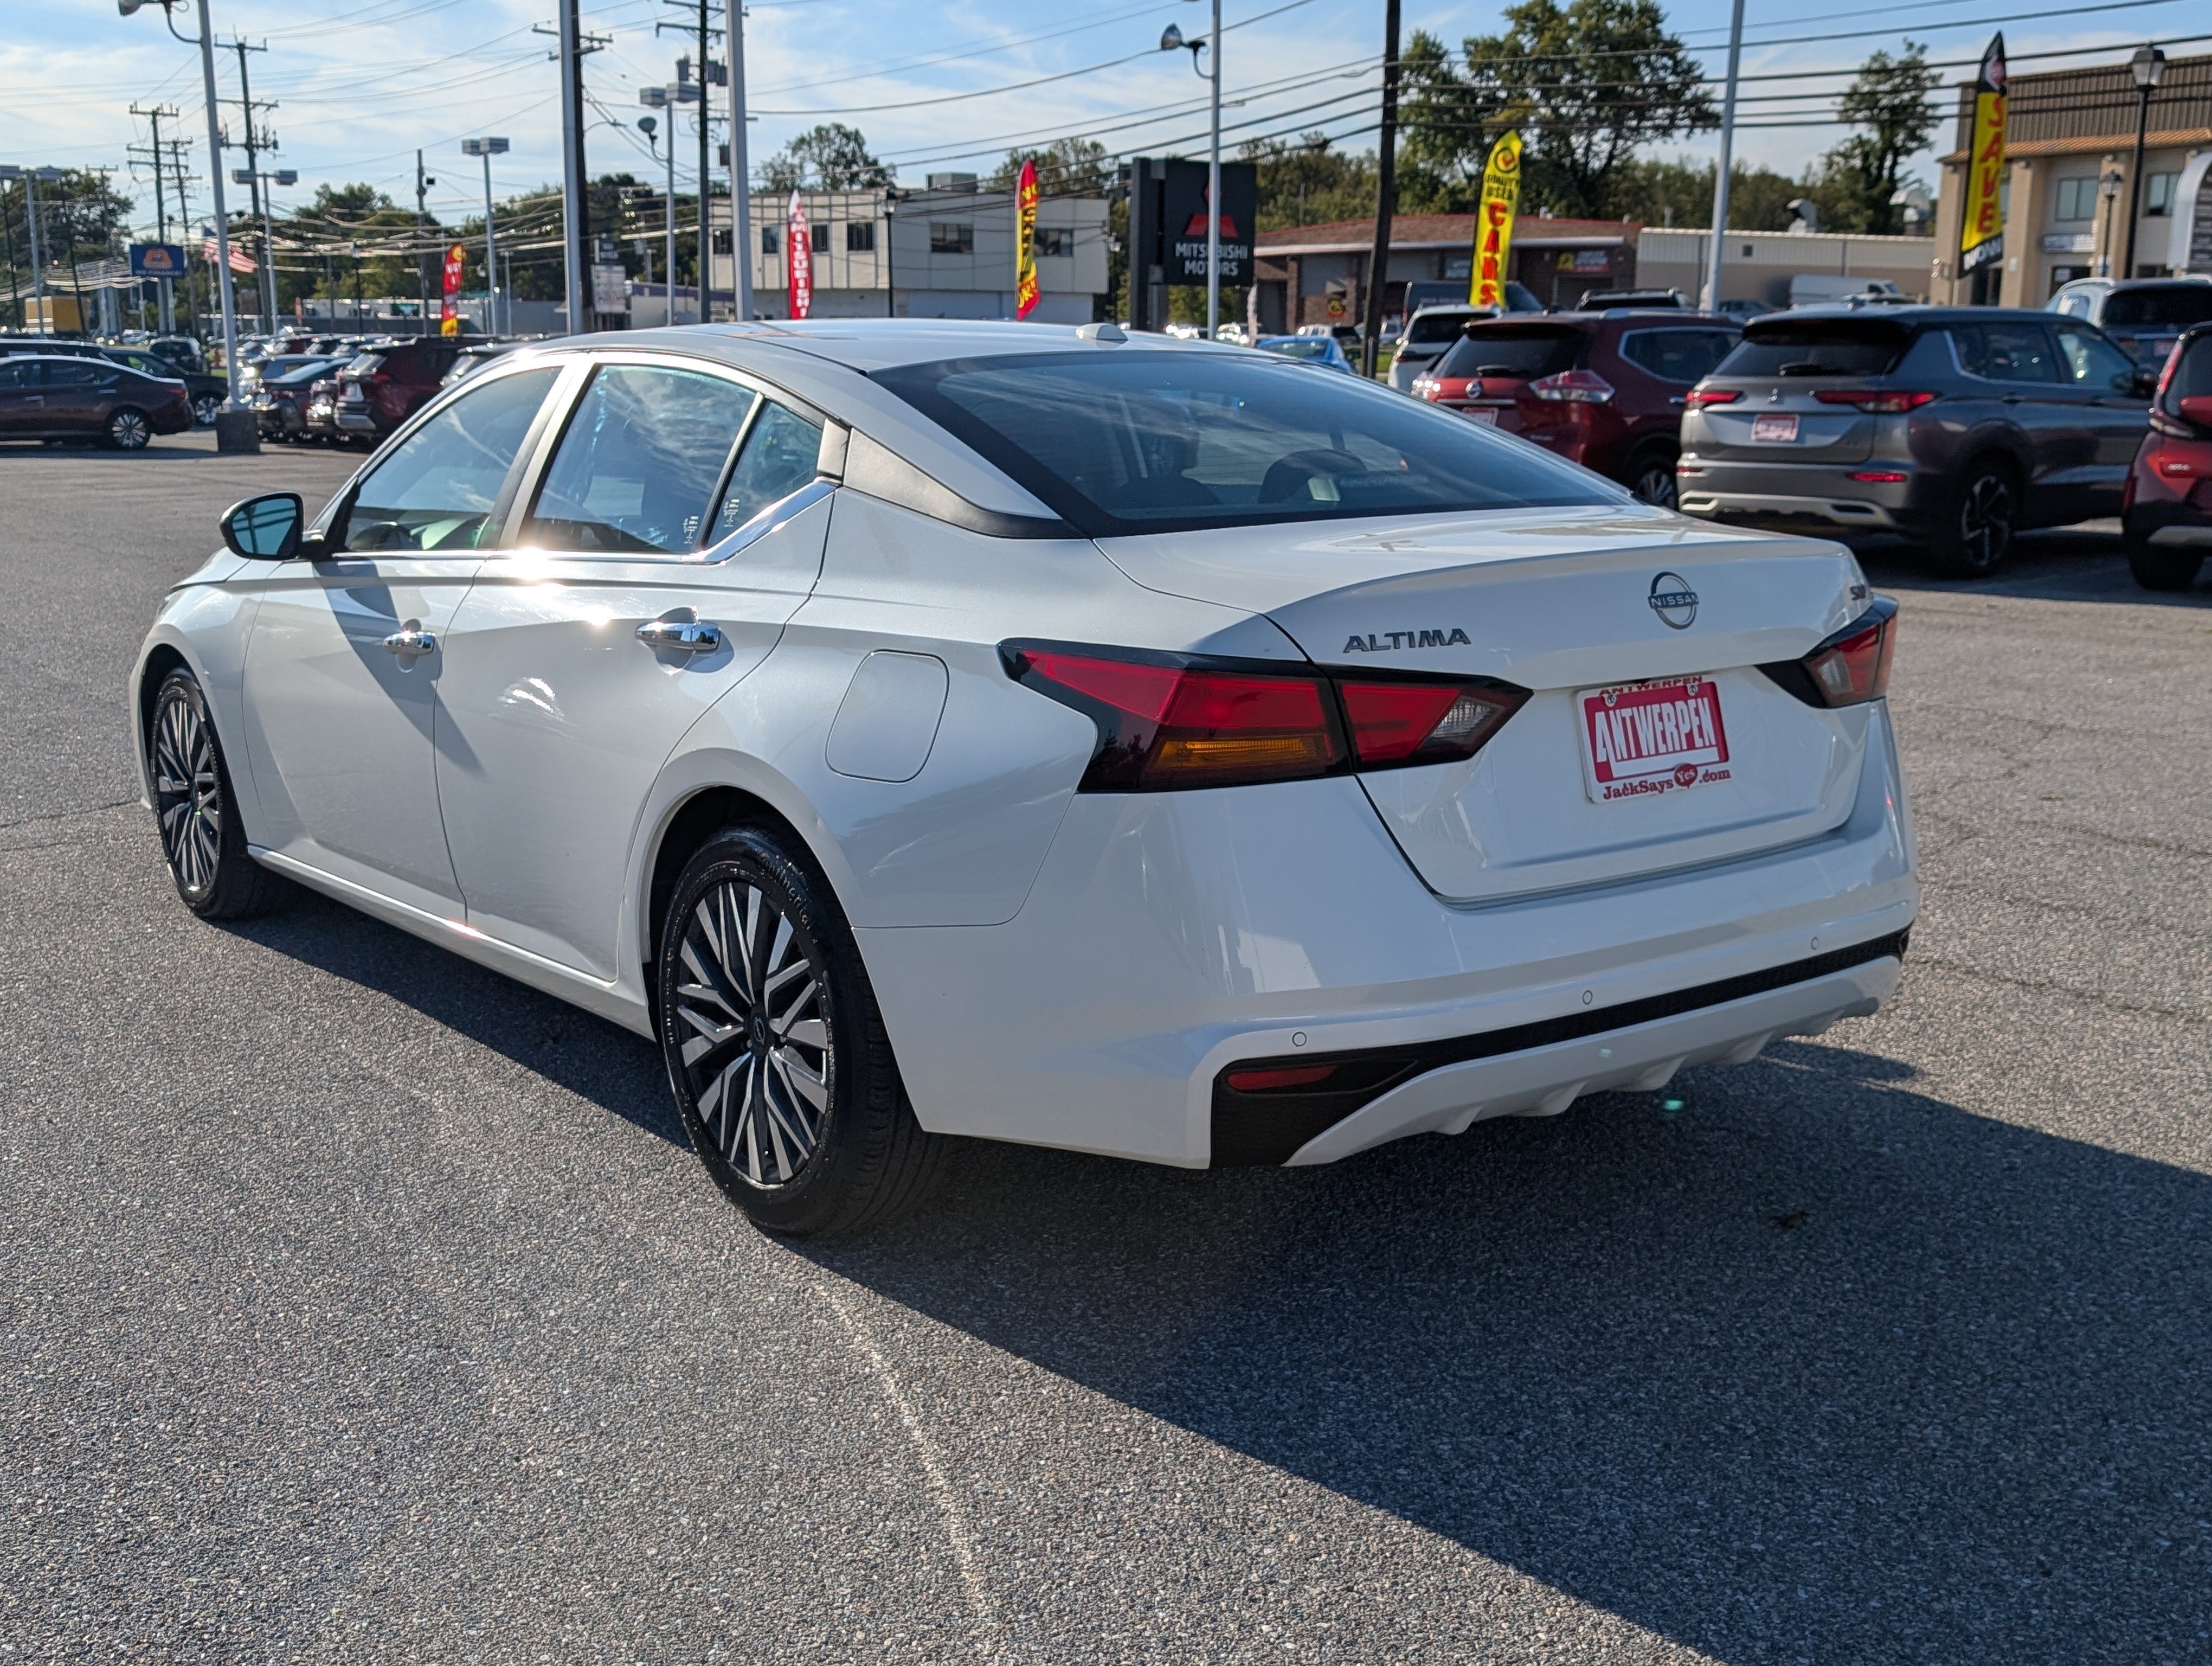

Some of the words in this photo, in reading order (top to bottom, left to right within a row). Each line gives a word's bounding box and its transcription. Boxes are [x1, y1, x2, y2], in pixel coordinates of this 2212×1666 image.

[1977, 97, 2003, 233] SAVE
[1479, 202, 1508, 306] CARS
[1963, 236, 2003, 271] NOW
[1650, 594, 1699, 607] NISSAN
[1342, 628, 1472, 653] ALTIMA
[1594, 697, 1716, 763] ANTWERPEN
